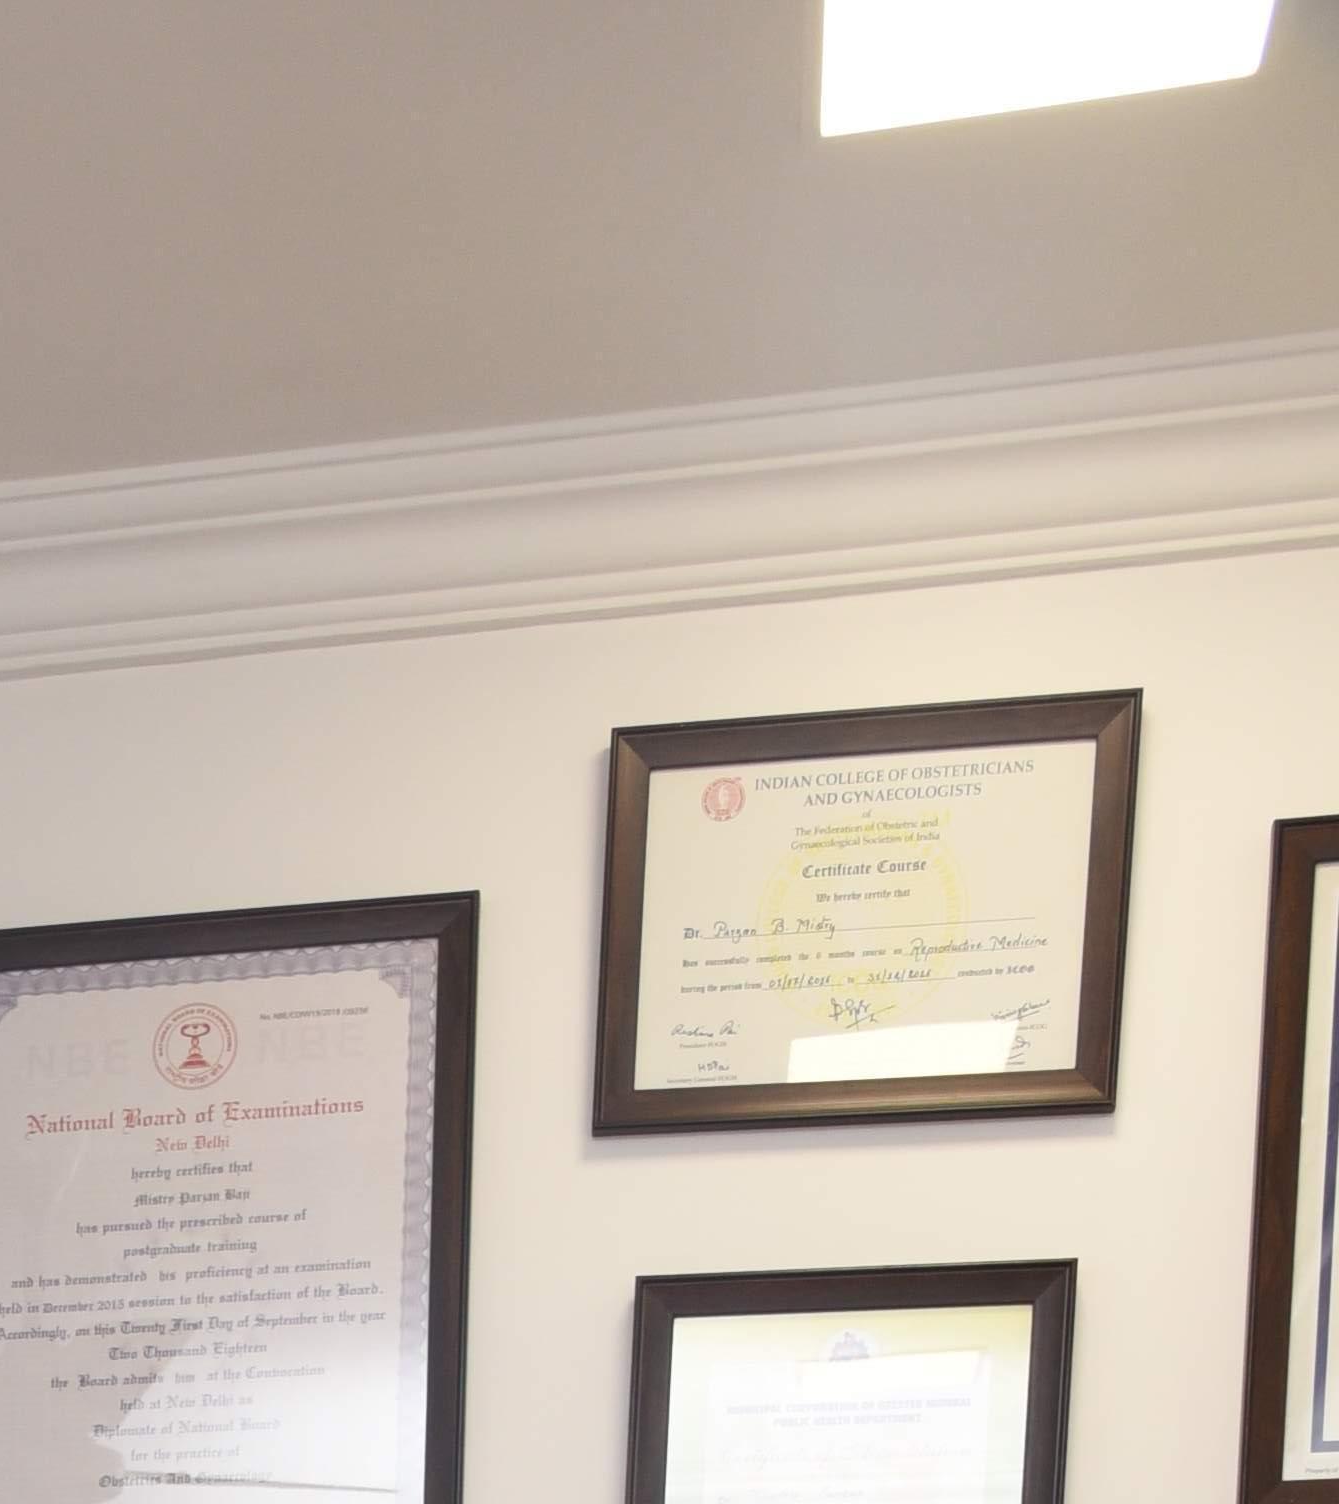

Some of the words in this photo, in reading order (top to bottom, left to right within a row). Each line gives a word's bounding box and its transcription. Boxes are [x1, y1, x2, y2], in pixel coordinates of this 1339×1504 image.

[754, 774, 813, 791] INDIAN
[814, 768, 884, 786] COLLEGE
[886, 766, 909, 782] OF
[910, 759, 1034, 779] OBSTETRICIANS
[802, 791, 839, 807] AND
[840, 782, 982, 804] GYNAECOLOGISTS
[800, 862, 872, 879] Certificate
[875, 858, 927, 874] Course
[24, 1111, 114, 1136] National
[121, 1106, 187, 1129] Board
[194, 1102, 215, 1124] of
[221, 1097, 364, 1121] Examinations
[154, 1136, 188, 1153] New
[192, 1134, 230, 1151] Delhi
[129, 1165, 172, 1182] hereby
[174, 1161, 224, 1177] certifies
[227, 1160, 253, 1177] that
[74, 1221, 99, 1237] has
[101, 1218, 153, 1236] pursued
[156, 1216, 175, 1231] the
[178, 1212, 244, 1232] prescribed
[247, 1213, 290, 1224] course
[292, 1207, 308, 1222] of
[122, 1242, 201, 1259] postgraduate
[206, 1238, 258, 1254] training
